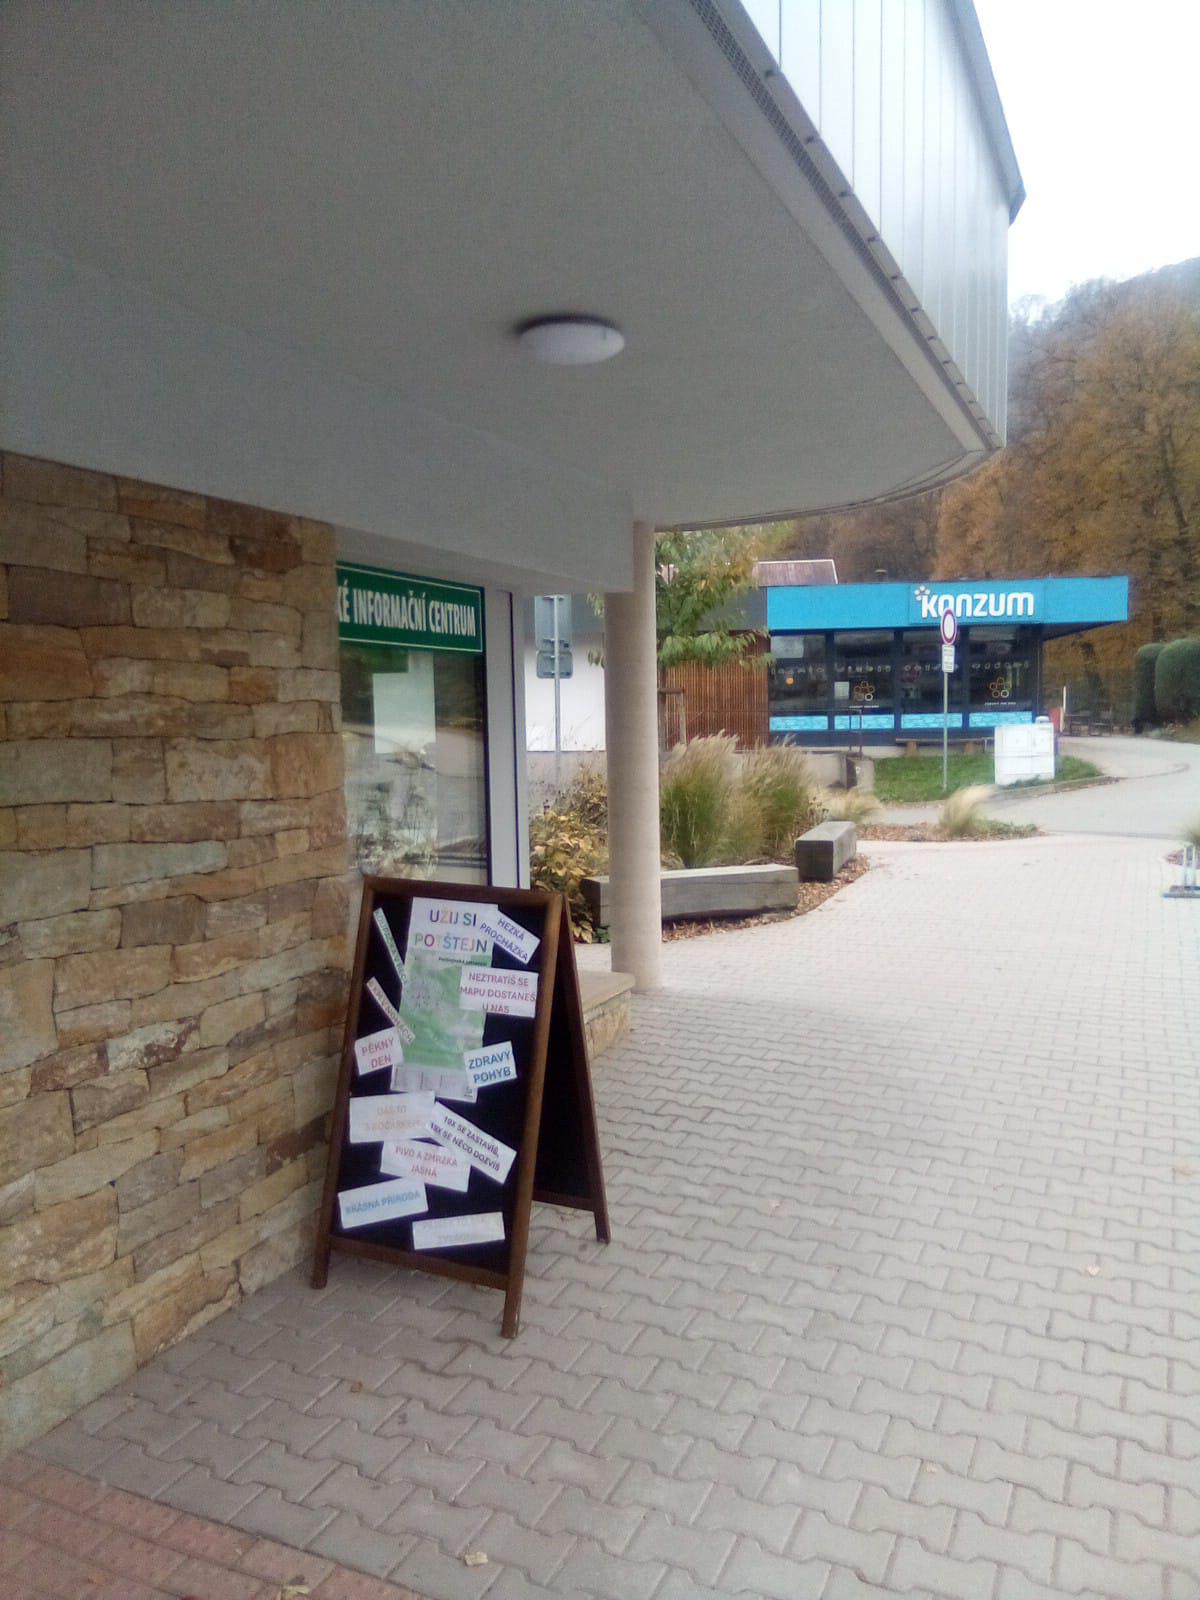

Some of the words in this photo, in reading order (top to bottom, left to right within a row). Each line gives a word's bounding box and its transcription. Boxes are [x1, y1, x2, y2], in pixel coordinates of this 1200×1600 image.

[353, 589, 427, 632] INFORMAČNÍ
[429, 599, 476, 637] CENTRUM
[429, 908, 459, 925] UŽIJ
[462, 912, 477, 928] SI
[497, 918, 525, 941] HEZKÁ
[414, 932, 488, 953] POTŠTEJN
[479, 923, 529, 962] PROCHÁZKA
[468, 972, 517, 986] NEZTRATÍŠ
[518, 977, 529, 987] SE
[461, 986, 486, 998] MAPU
[482, 1004, 488, 1013] U
[361, 1035, 394, 1056] PĚKNÝ
[370, 1055, 392, 1069] DEN
[468, 1047, 511, 1070] ZDRAVÝ
[473, 1066, 511, 1084] POHYB
[442, 1128, 453, 1140] SE
[456, 1121, 467, 1133] SE
[395, 1145, 415, 1158] PIVO
[416, 1151, 423, 1160] A
